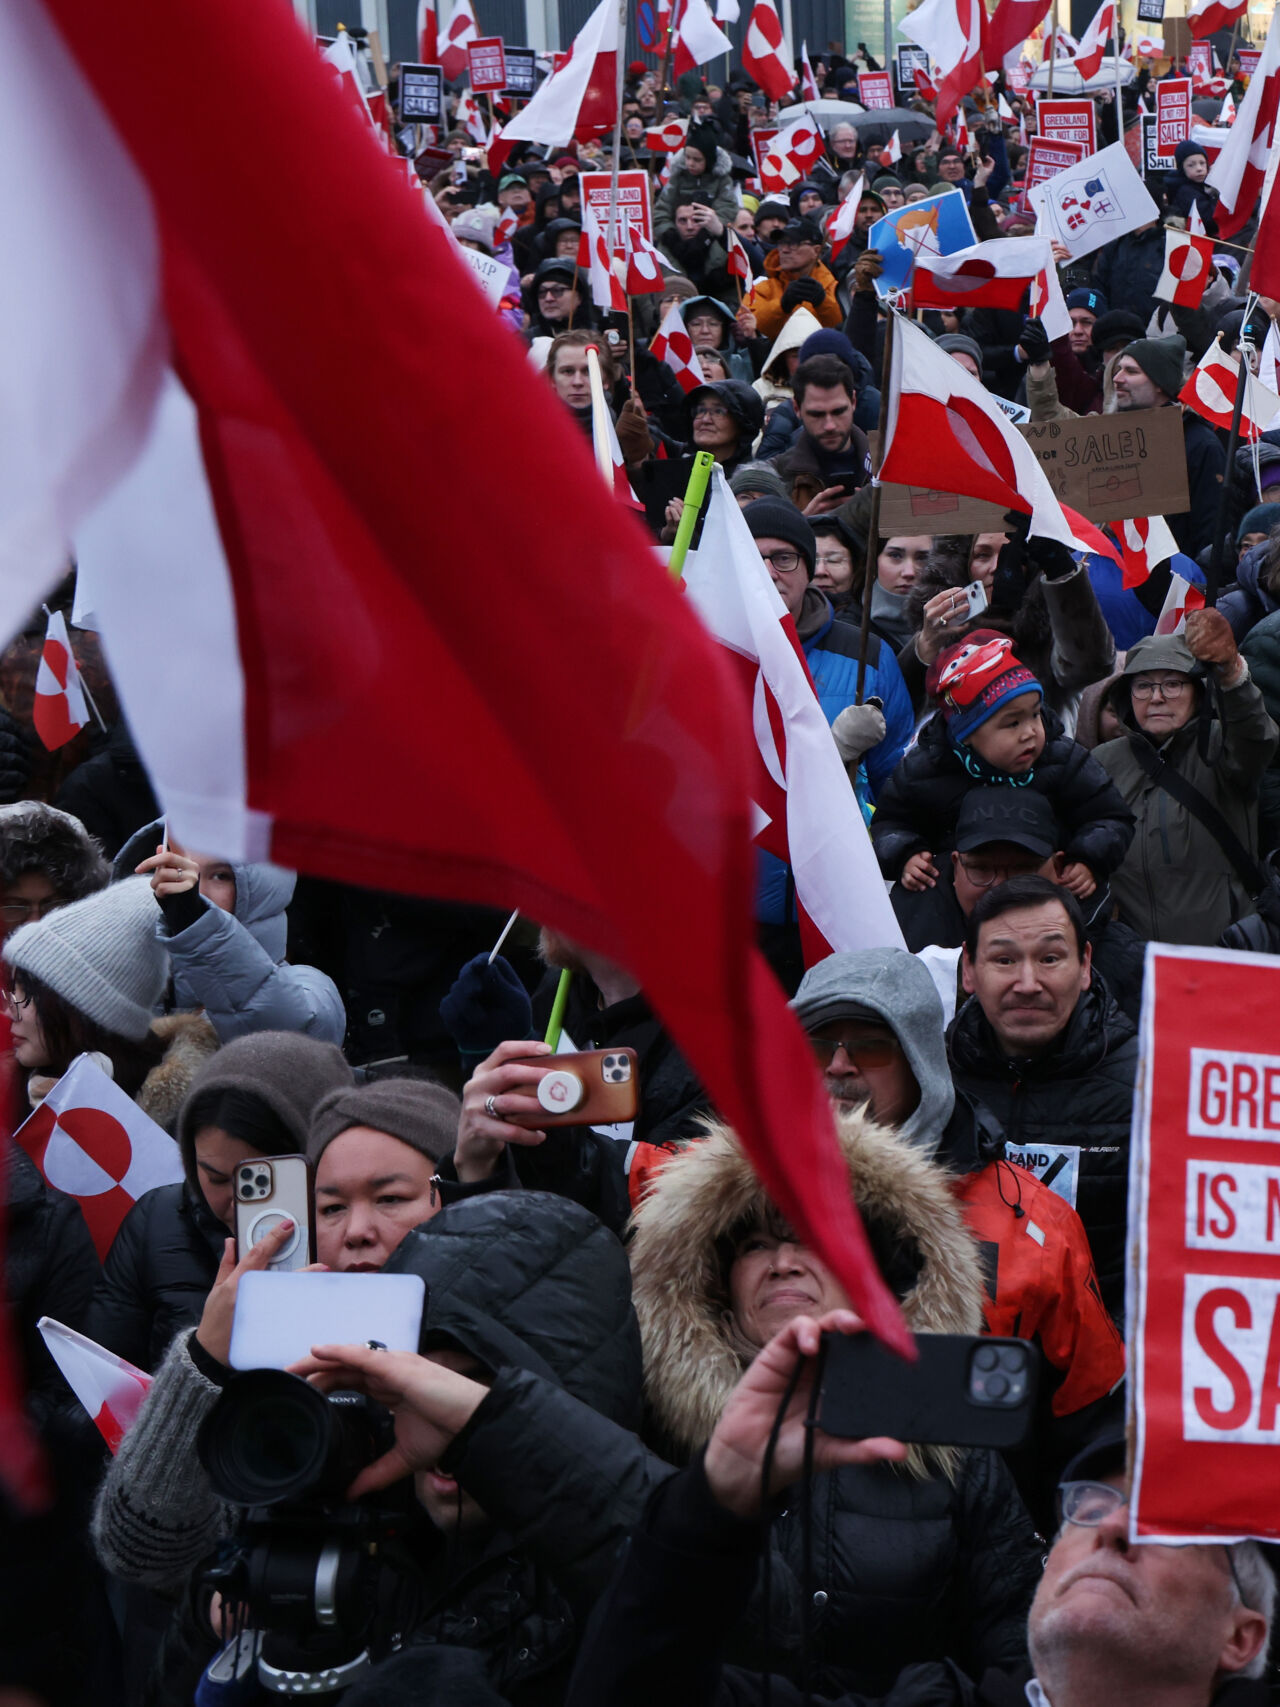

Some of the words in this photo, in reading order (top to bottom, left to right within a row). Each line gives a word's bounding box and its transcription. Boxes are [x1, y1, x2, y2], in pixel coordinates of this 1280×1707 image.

[1045, 114, 1087, 126] GREENLAND
[1046, 131, 1054, 139] IS
[1057, 131, 1070, 140] NOT
[1074, 130, 1088, 140] FOR
[1161, 123, 1185, 144] SALE!
[1035, 149, 1077, 165] GREENLAND
[1044, 167, 1058, 177] NOT
[592, 189, 640, 201] GREELAND
[1064, 427, 1147, 468] SALE!
[971, 803, 1038, 825] NYC
[1196, 1171, 1239, 1240] IS
